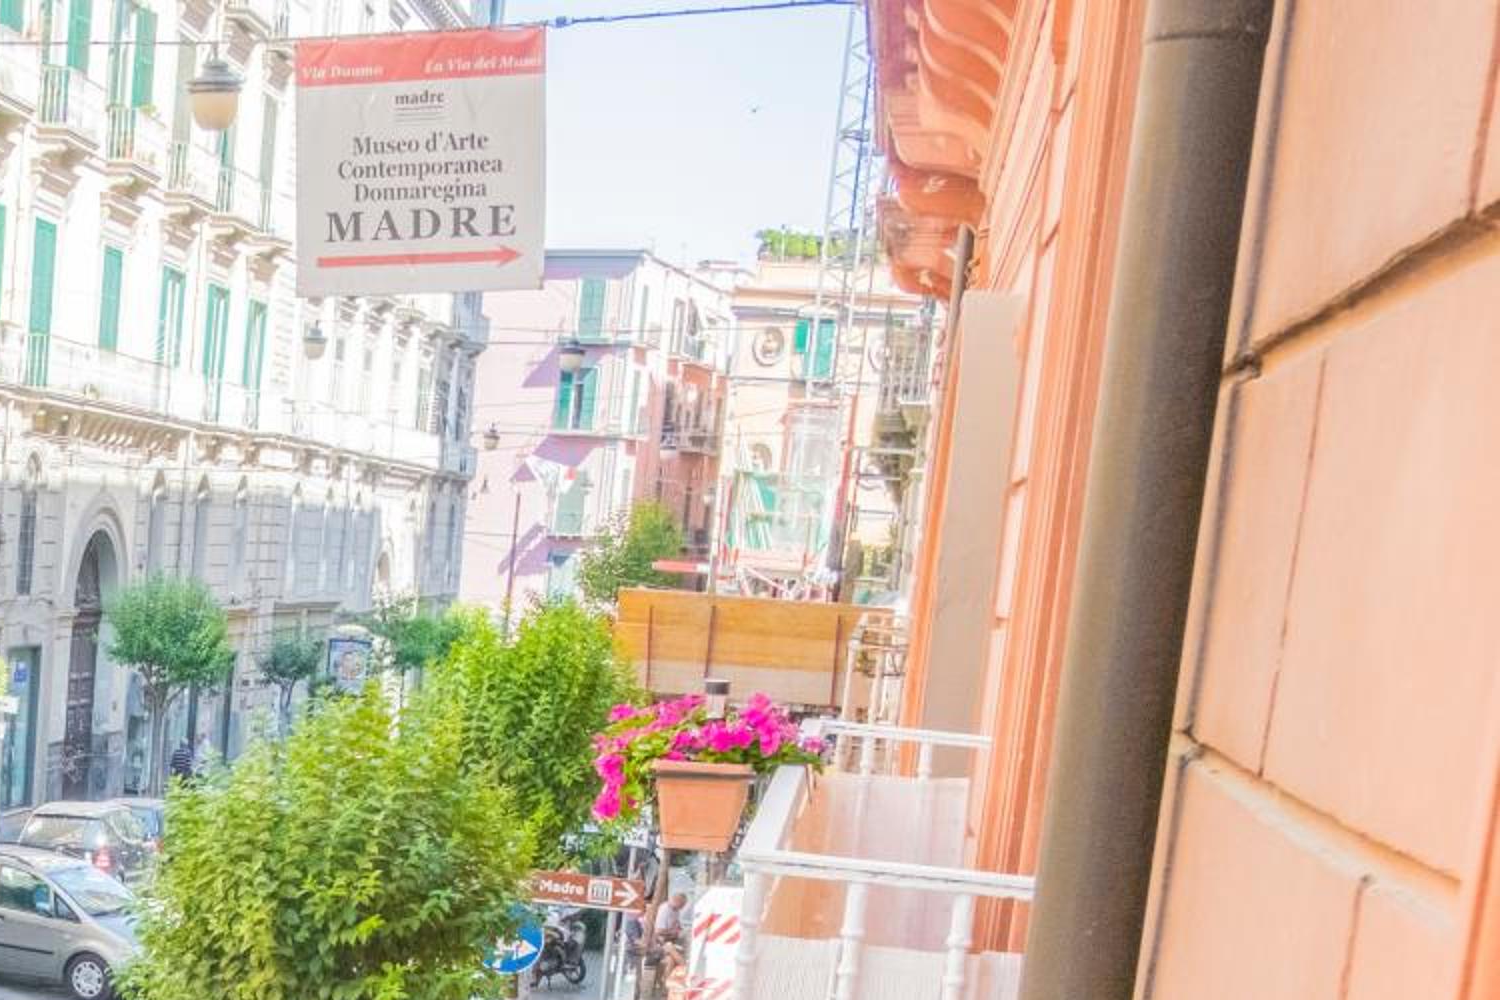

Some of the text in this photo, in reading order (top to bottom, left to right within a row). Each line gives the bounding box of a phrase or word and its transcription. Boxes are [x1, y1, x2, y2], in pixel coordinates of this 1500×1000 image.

[394, 89, 445, 105] madre
[352, 131, 489, 156] Museo d'Arte
[337, 158, 504, 181] Contemporanea
[354, 178, 487, 203] Donnaregina
[324, 204, 517, 243] MADRE
[539, 879, 585, 896] Madre
